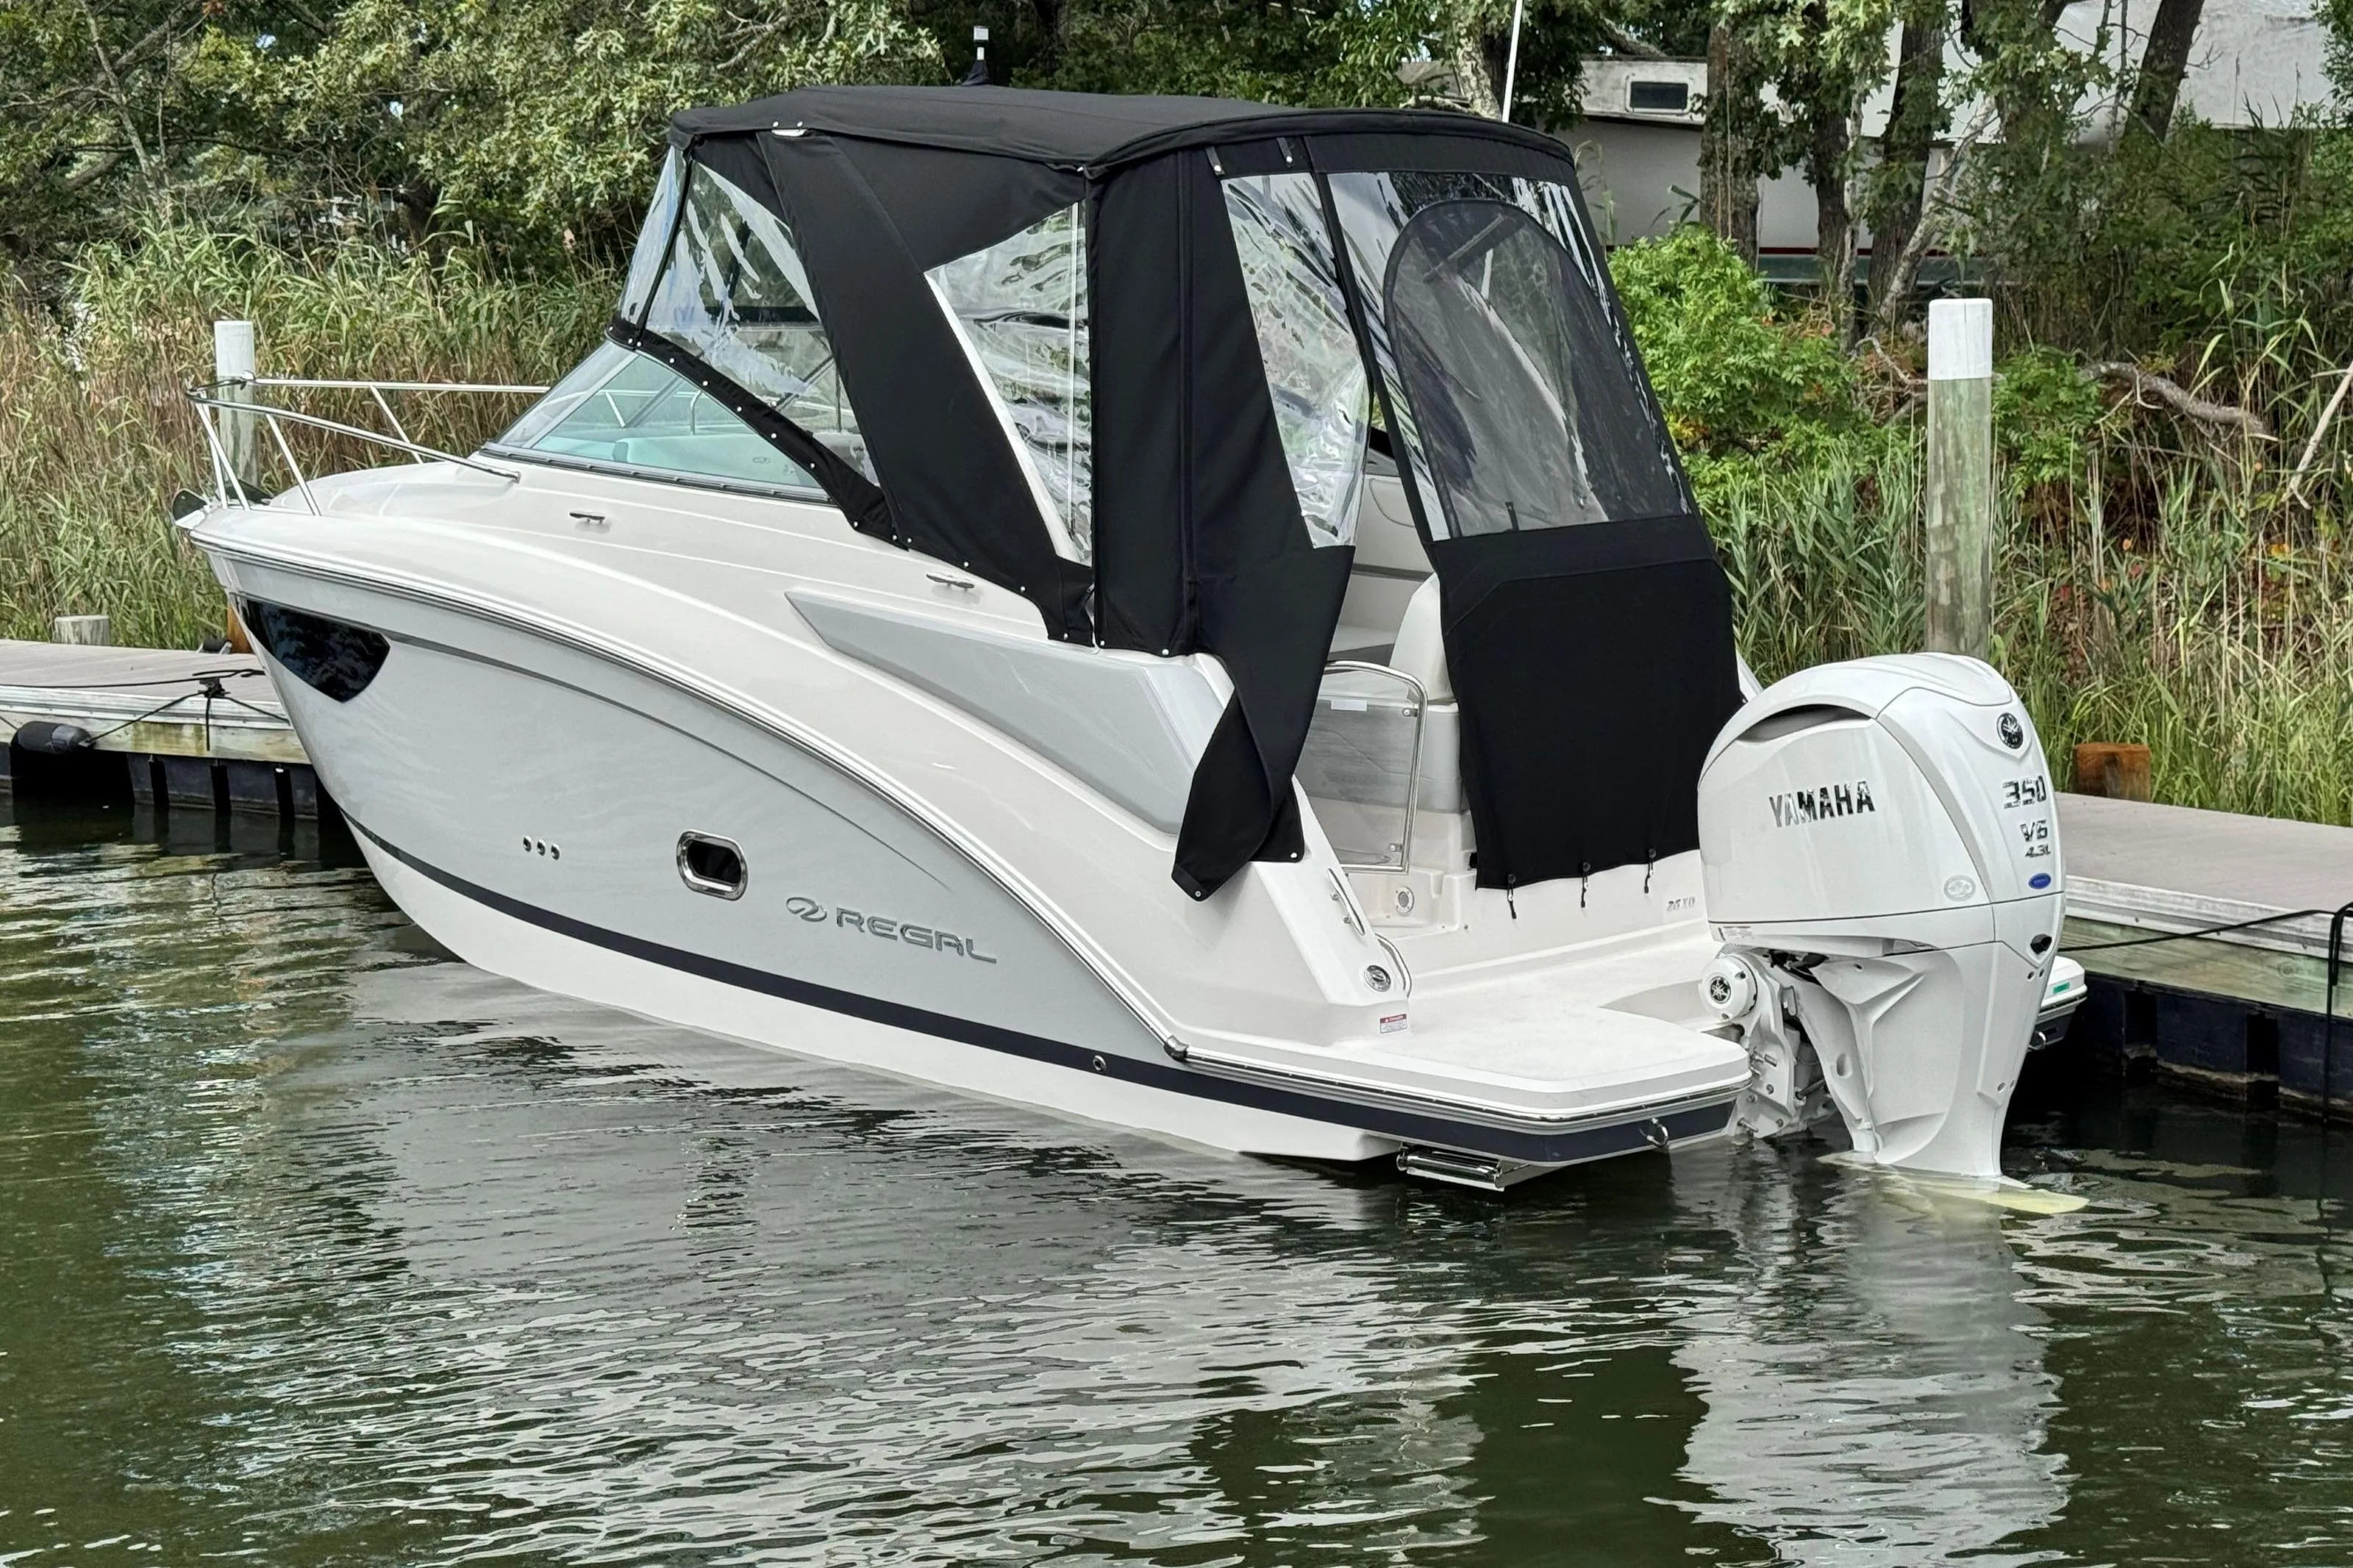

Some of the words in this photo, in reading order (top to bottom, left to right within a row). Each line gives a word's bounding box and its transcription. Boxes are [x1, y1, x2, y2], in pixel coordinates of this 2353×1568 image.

[1768, 781, 1875, 828] YAMAHA
[2002, 775, 2046, 809] 350
[2020, 819, 2048, 842] V6
[836, 906, 996, 964] REGAL
